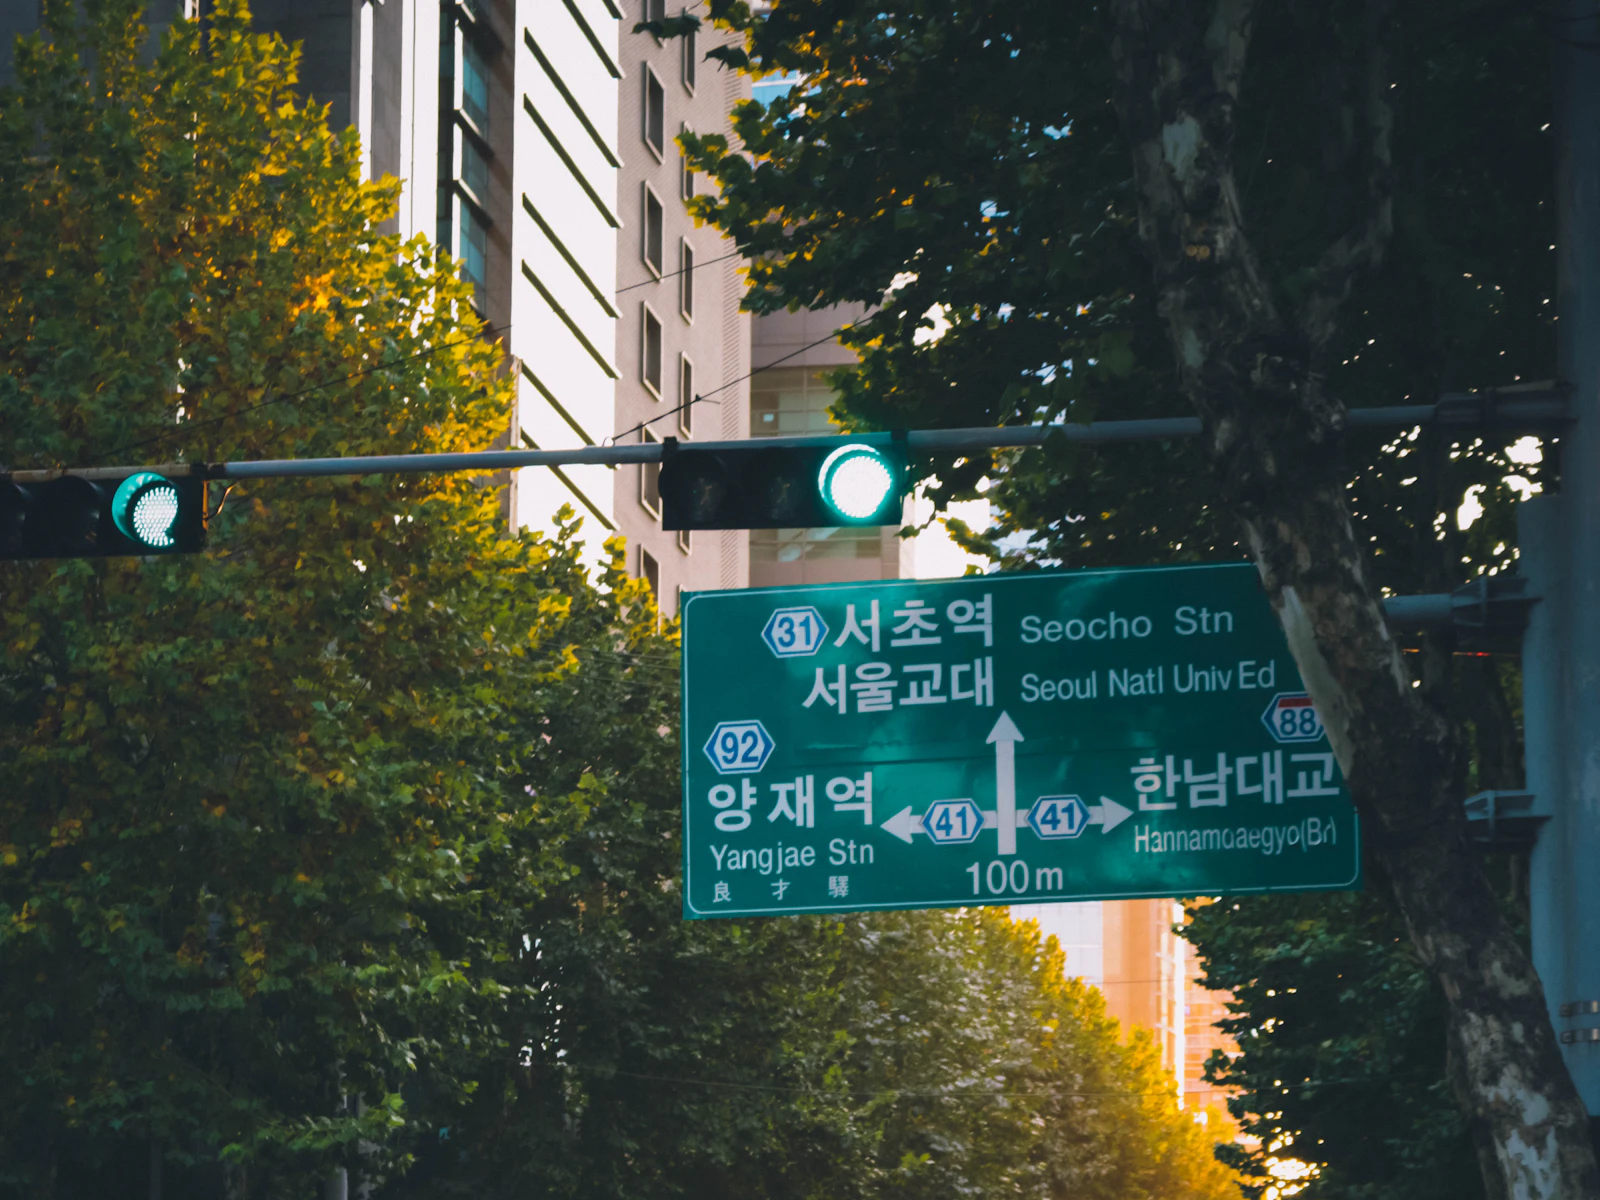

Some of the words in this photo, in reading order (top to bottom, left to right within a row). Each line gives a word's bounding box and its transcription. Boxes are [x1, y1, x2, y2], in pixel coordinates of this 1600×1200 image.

[777, 615, 811, 648] 31
[833, 594, 993, 652] 서초역
[1020, 611, 1152, 643] Seocho
[1174, 606, 1234, 636] Stn
[802, 656, 994, 714] 서울교대
[1020, 671, 1097, 702] Seoul
[1109, 666, 1164, 697] Natl
[1173, 664, 1232, 693] Univ
[1239, 660, 1275, 689] Ed
[1279, 708, 1315, 736] 88
[720, 730, 759, 764] 92
[0, 753, 90, 795] 039
[1130, 750, 1340, 811] 한남대교
[707, 772, 873, 832] 양재역
[1042, 802, 1076, 831] 41
[935, 806, 967, 837] 41
[710, 842, 816, 875] Yangjae
[828, 838, 874, 866] Stn
